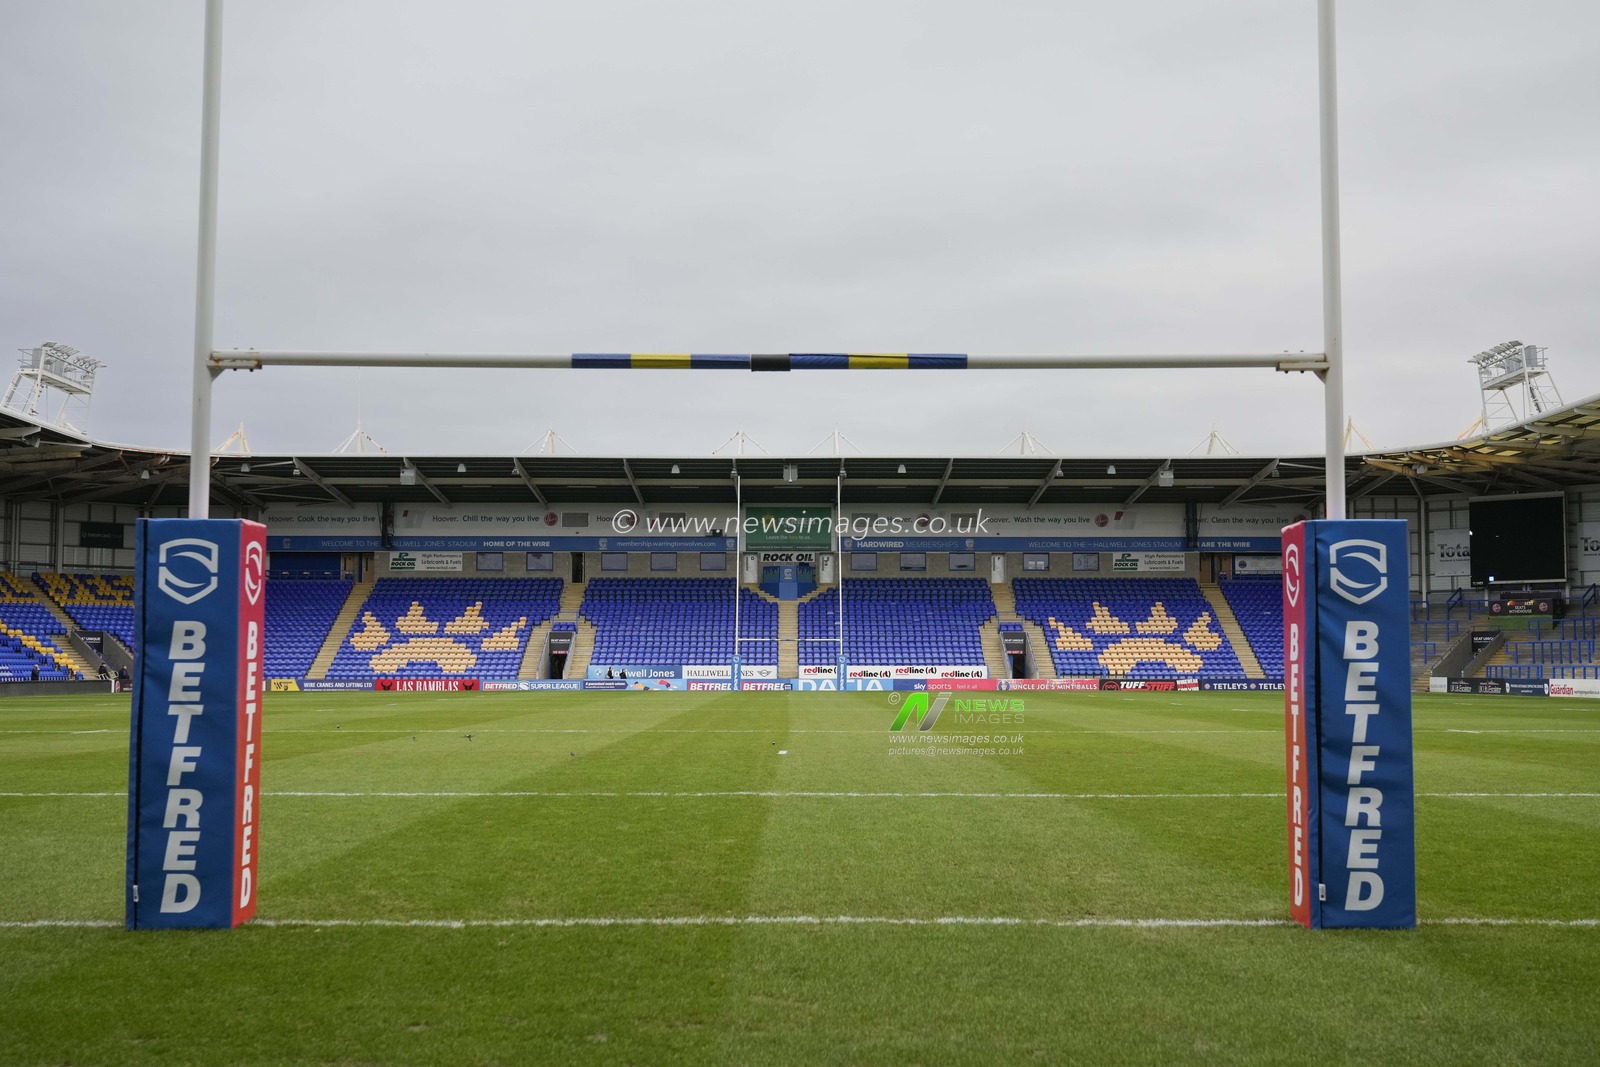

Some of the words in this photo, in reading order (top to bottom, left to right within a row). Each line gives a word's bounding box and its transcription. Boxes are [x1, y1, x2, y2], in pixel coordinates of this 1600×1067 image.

[317, 515, 329, 523] the
[331, 517, 345, 525] way
[347, 517, 360, 525] you
[362, 515, 376, 523] live
[462, 515, 478, 523] Chill
[480, 515, 493, 523] the
[496, 517, 510, 525] way
[512, 517, 526, 525] you
[527, 515, 540, 523] live
[1246, 518, 1259, 526] way
[1261, 518, 1274, 526] you
[1276, 516, 1289, 524] live
[616, 540, 716, 548] membership.warringtonwolves.com
[1580, 537, 1600, 552] To
[1437, 543, 1471, 558] Tota
[762, 553, 793, 562] ROCK
[795, 553, 813, 562] OIL
[648, 669, 675, 678] Jones
[803, 666, 833, 674] redline
[849, 670, 879, 678] redline
[895, 666, 925, 674] redline
[941, 670, 970, 678] redline
[396, 680, 414, 691] LAS
[416, 680, 459, 691] RAMBLAS
[914, 683, 926, 691] sky
[927, 683, 952, 691] sports
[159, 620, 207, 914] BETFRED
[239, 620, 259, 910] BETFRED
[1289, 623, 1304, 907] BETFRED
[1342, 620, 1385, 912] BETFRED
